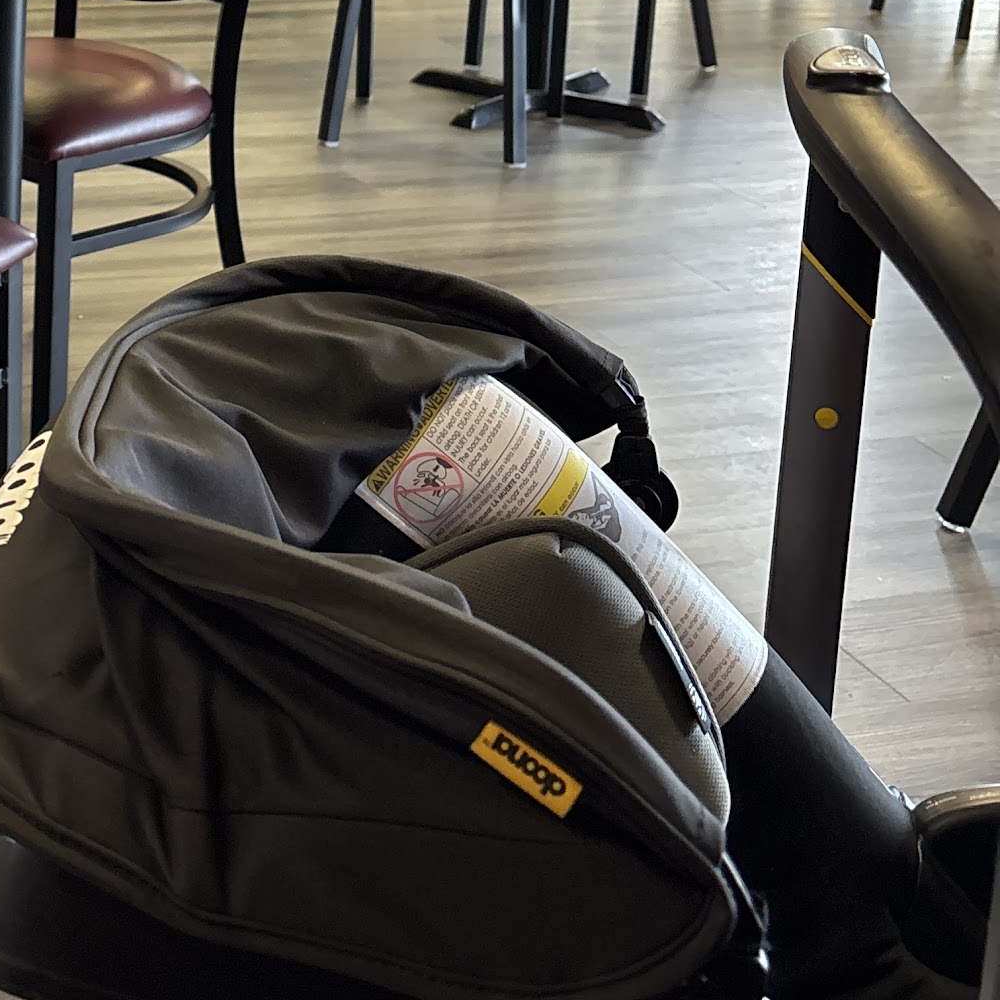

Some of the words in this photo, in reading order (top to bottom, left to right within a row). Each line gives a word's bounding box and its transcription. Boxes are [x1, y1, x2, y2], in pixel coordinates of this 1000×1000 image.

[457, 393, 471, 408] front
[502, 400, 511, 413] and
[426, 425, 437, 438] DO
[433, 412, 446, 427] NOT
[442, 396, 458, 415] place
[445, 415, 457, 429] seat
[454, 407, 462, 416] on
[456, 408, 473, 429] DEATH
[468, 400, 478, 410] OR
[499, 411, 507, 420] 12
[433, 427, 448, 444] child
[450, 434, 468, 457] INJURY
[465, 423, 476, 437] can
[473, 405, 488, 424] occur.
[457, 450, 469, 464] The
[466, 435, 481, 452] back
[477, 422, 489, 437] seat
[487, 408, 498, 418] the
[484, 419, 504, 443] children
[479, 442, 488, 452] for
[465, 450, 482, 471] place
[474, 456, 491, 477] under.
[490, 498, 499, 507] LA
[497, 478, 517, 500] MUERTE
[517, 448, 537, 473] LESIONES
[491, 481, 502, 494] con
[505, 487, 521, 505] lugar
[517, 476, 529, 490] más
[527, 458, 543, 478] seguro
[435, 527, 445, 537] NO
[494, 463, 505, 476] con
[558, 499, 568, 511] can
[566, 481, 580, 499] occur
[668, 594, 678, 605] the
[679, 612, 689, 623] the
[692, 631, 699, 639] or
[696, 642, 715, 666] securely
[706, 656, 727, 683] clothing
[711, 678, 723, 692] with
[491, 733, 566, 797] doona
